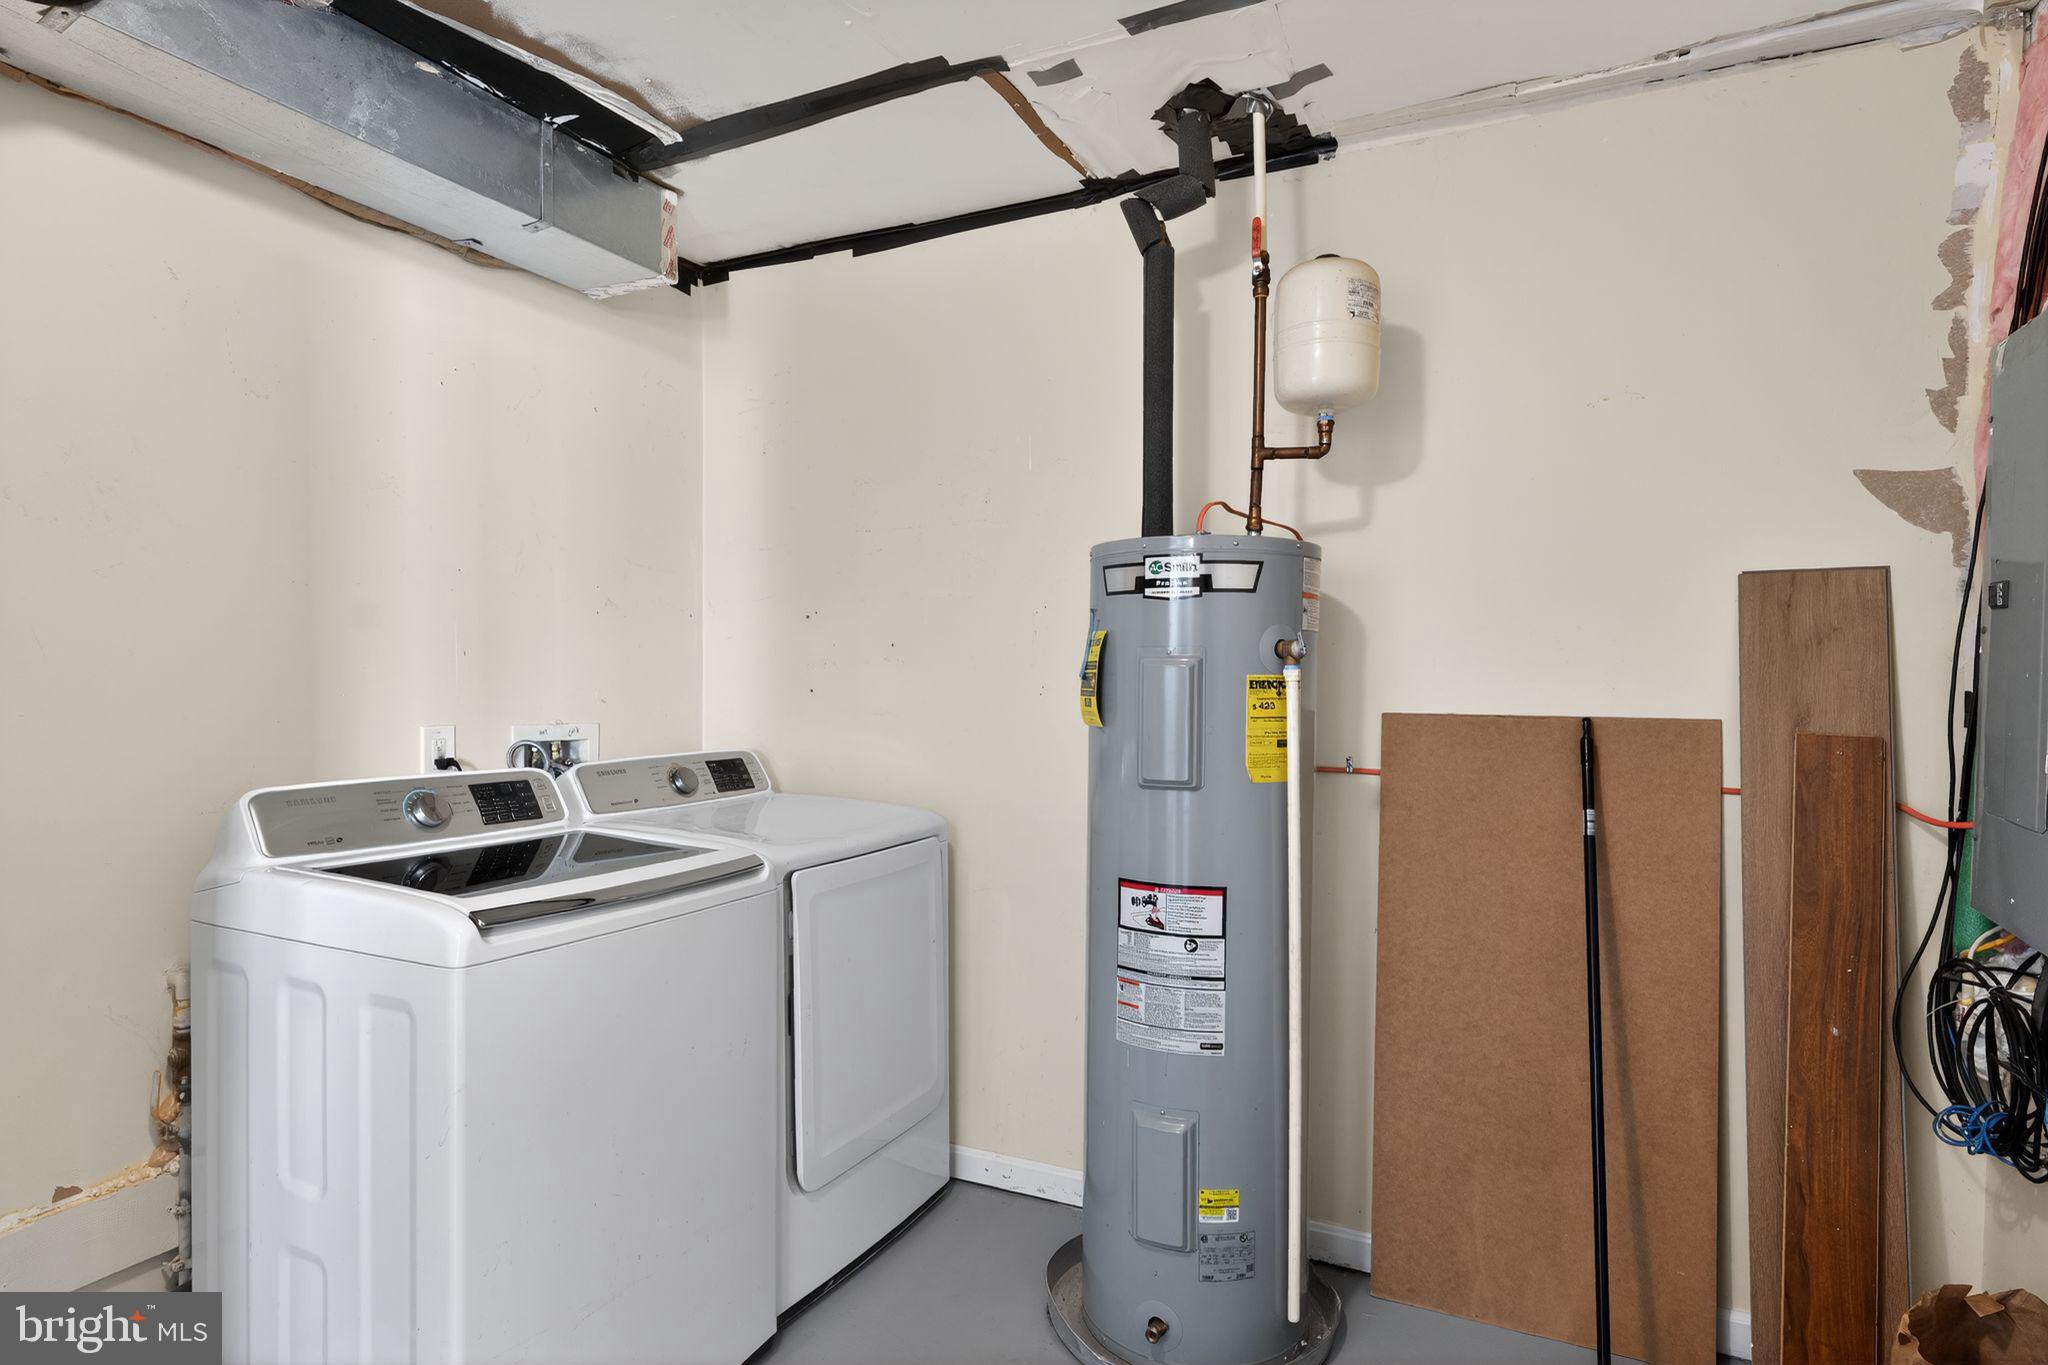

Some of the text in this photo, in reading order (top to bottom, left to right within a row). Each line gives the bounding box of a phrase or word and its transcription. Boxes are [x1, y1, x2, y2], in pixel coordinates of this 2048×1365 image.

[1164, 562, 1198, 573] Smith
[1258, 701, 1276, 710] 423
[596, 768, 627, 777] SAMSUNG
[286, 795, 336, 808] SAMSUNG
